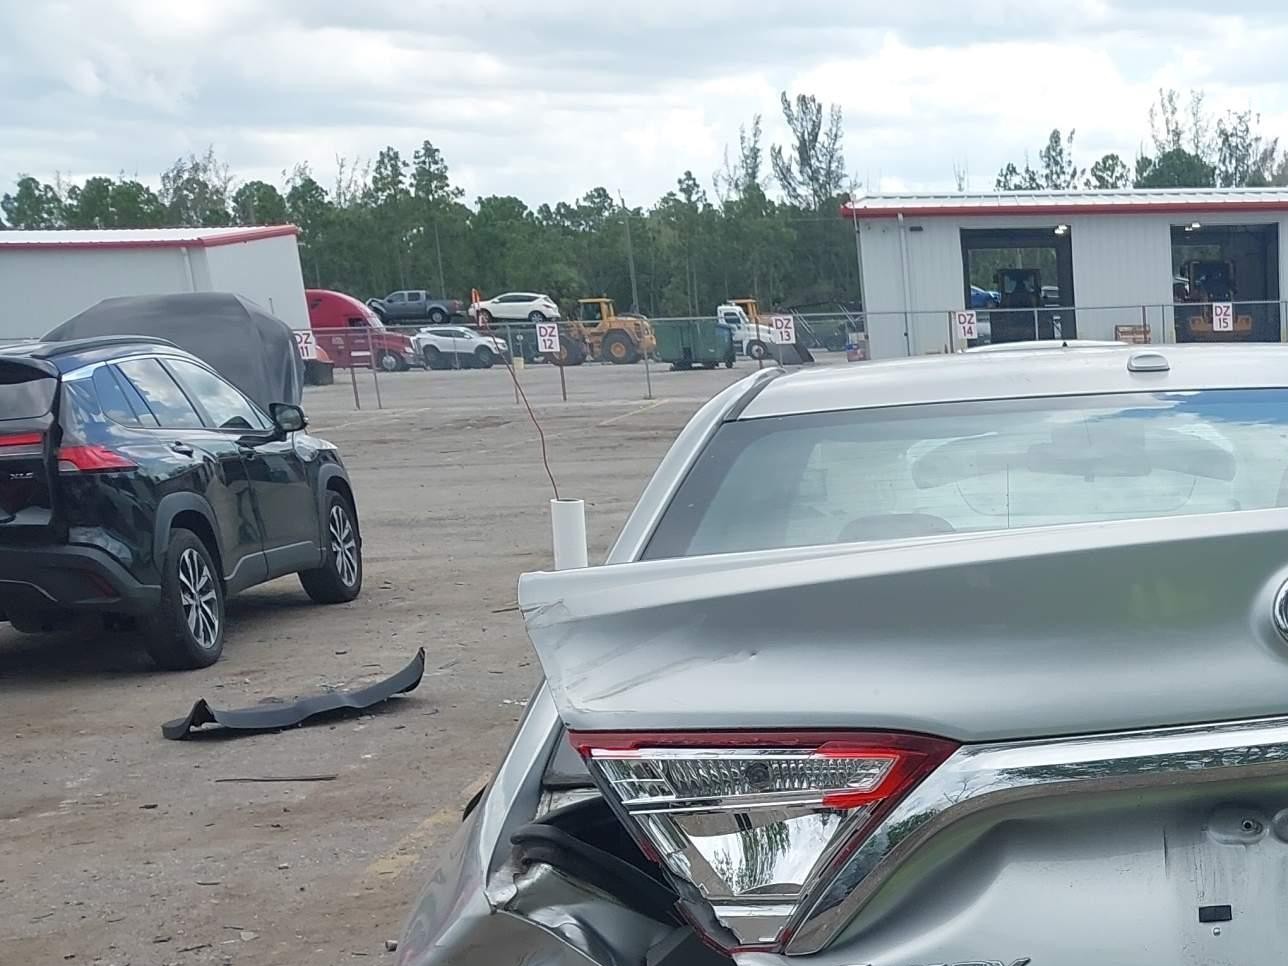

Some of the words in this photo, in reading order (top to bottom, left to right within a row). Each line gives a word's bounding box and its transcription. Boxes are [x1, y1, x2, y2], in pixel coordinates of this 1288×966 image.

[1214, 305, 1231, 317] DZ
[774, 318, 792, 330] DZ
[957, 313, 975, 325] DZ
[1218, 317, 1229, 329] 15
[539, 326, 557, 337] DZ
[779, 330, 791, 341] 13
[962, 326, 973, 337] 14
[543, 339, 554, 350] 12
[300, 346, 309, 357] 11
